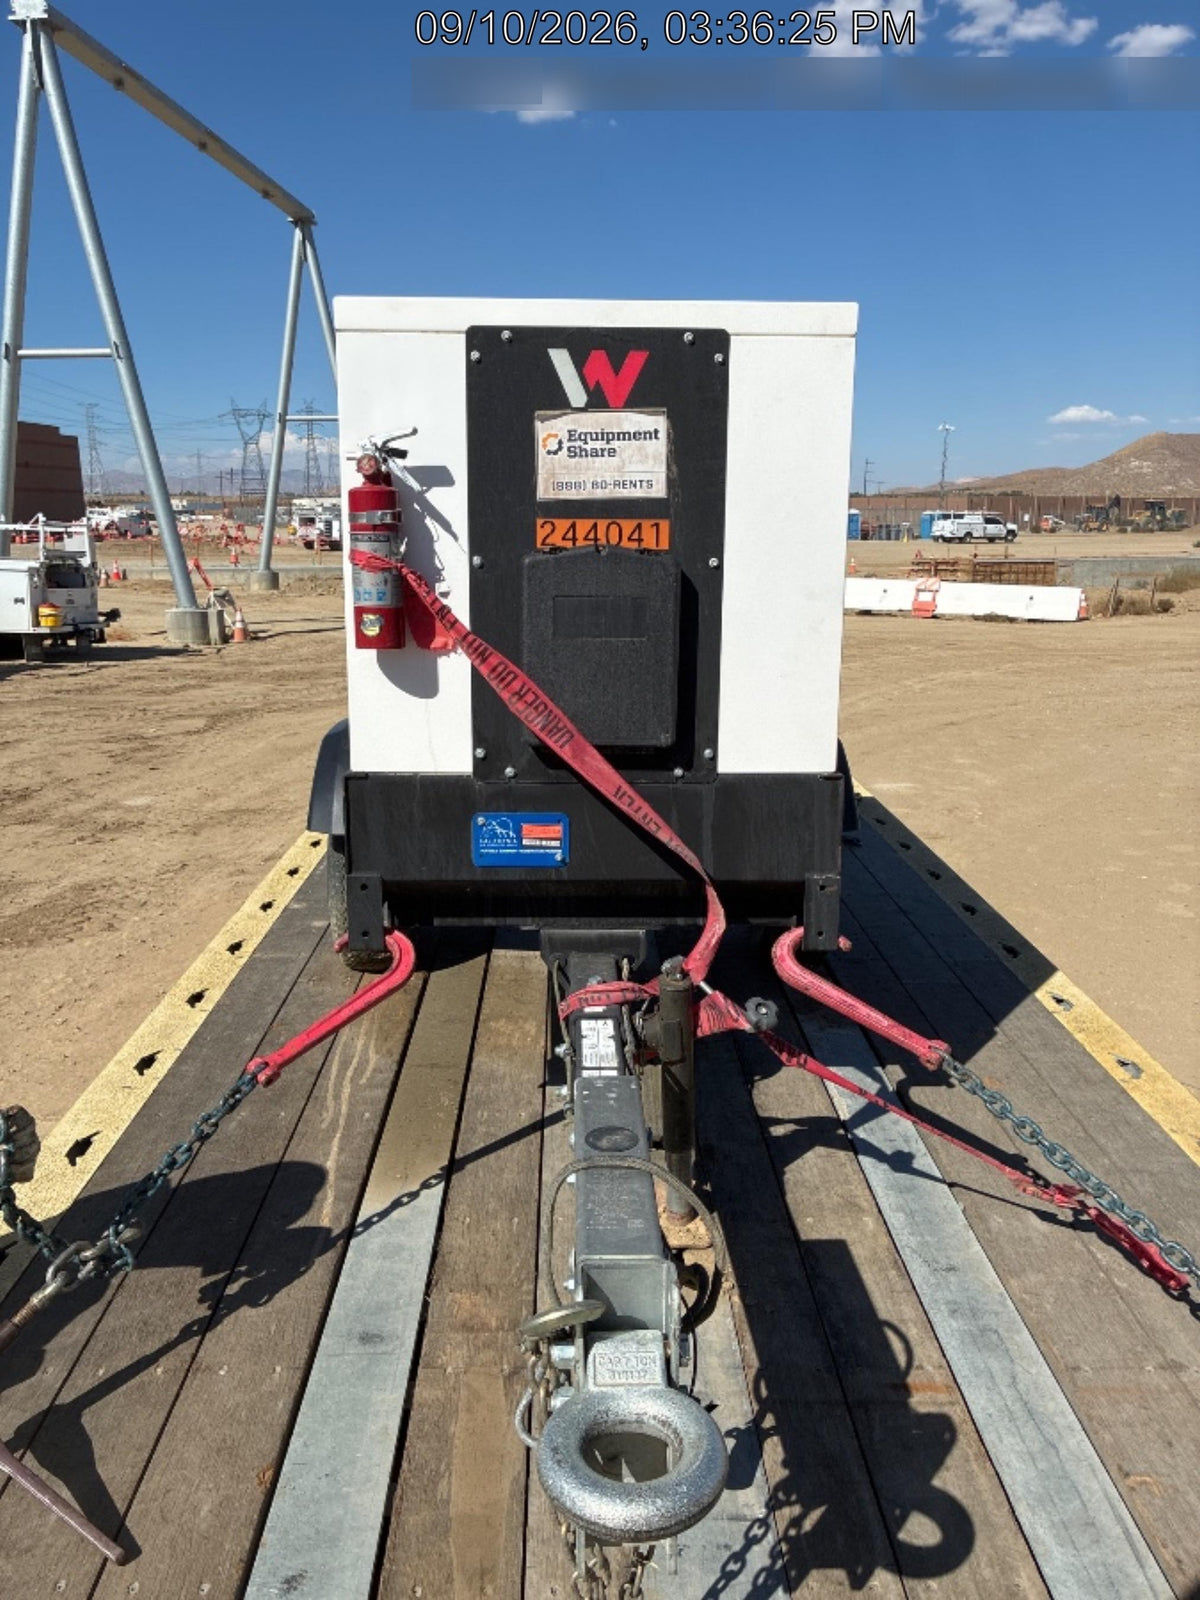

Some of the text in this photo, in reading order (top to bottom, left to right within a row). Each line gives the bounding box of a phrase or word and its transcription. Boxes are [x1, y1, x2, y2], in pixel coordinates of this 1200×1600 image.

[566, 428, 660, 444] Equipment
[566, 445, 617, 459] Share
[539, 520, 660, 548] 244041
